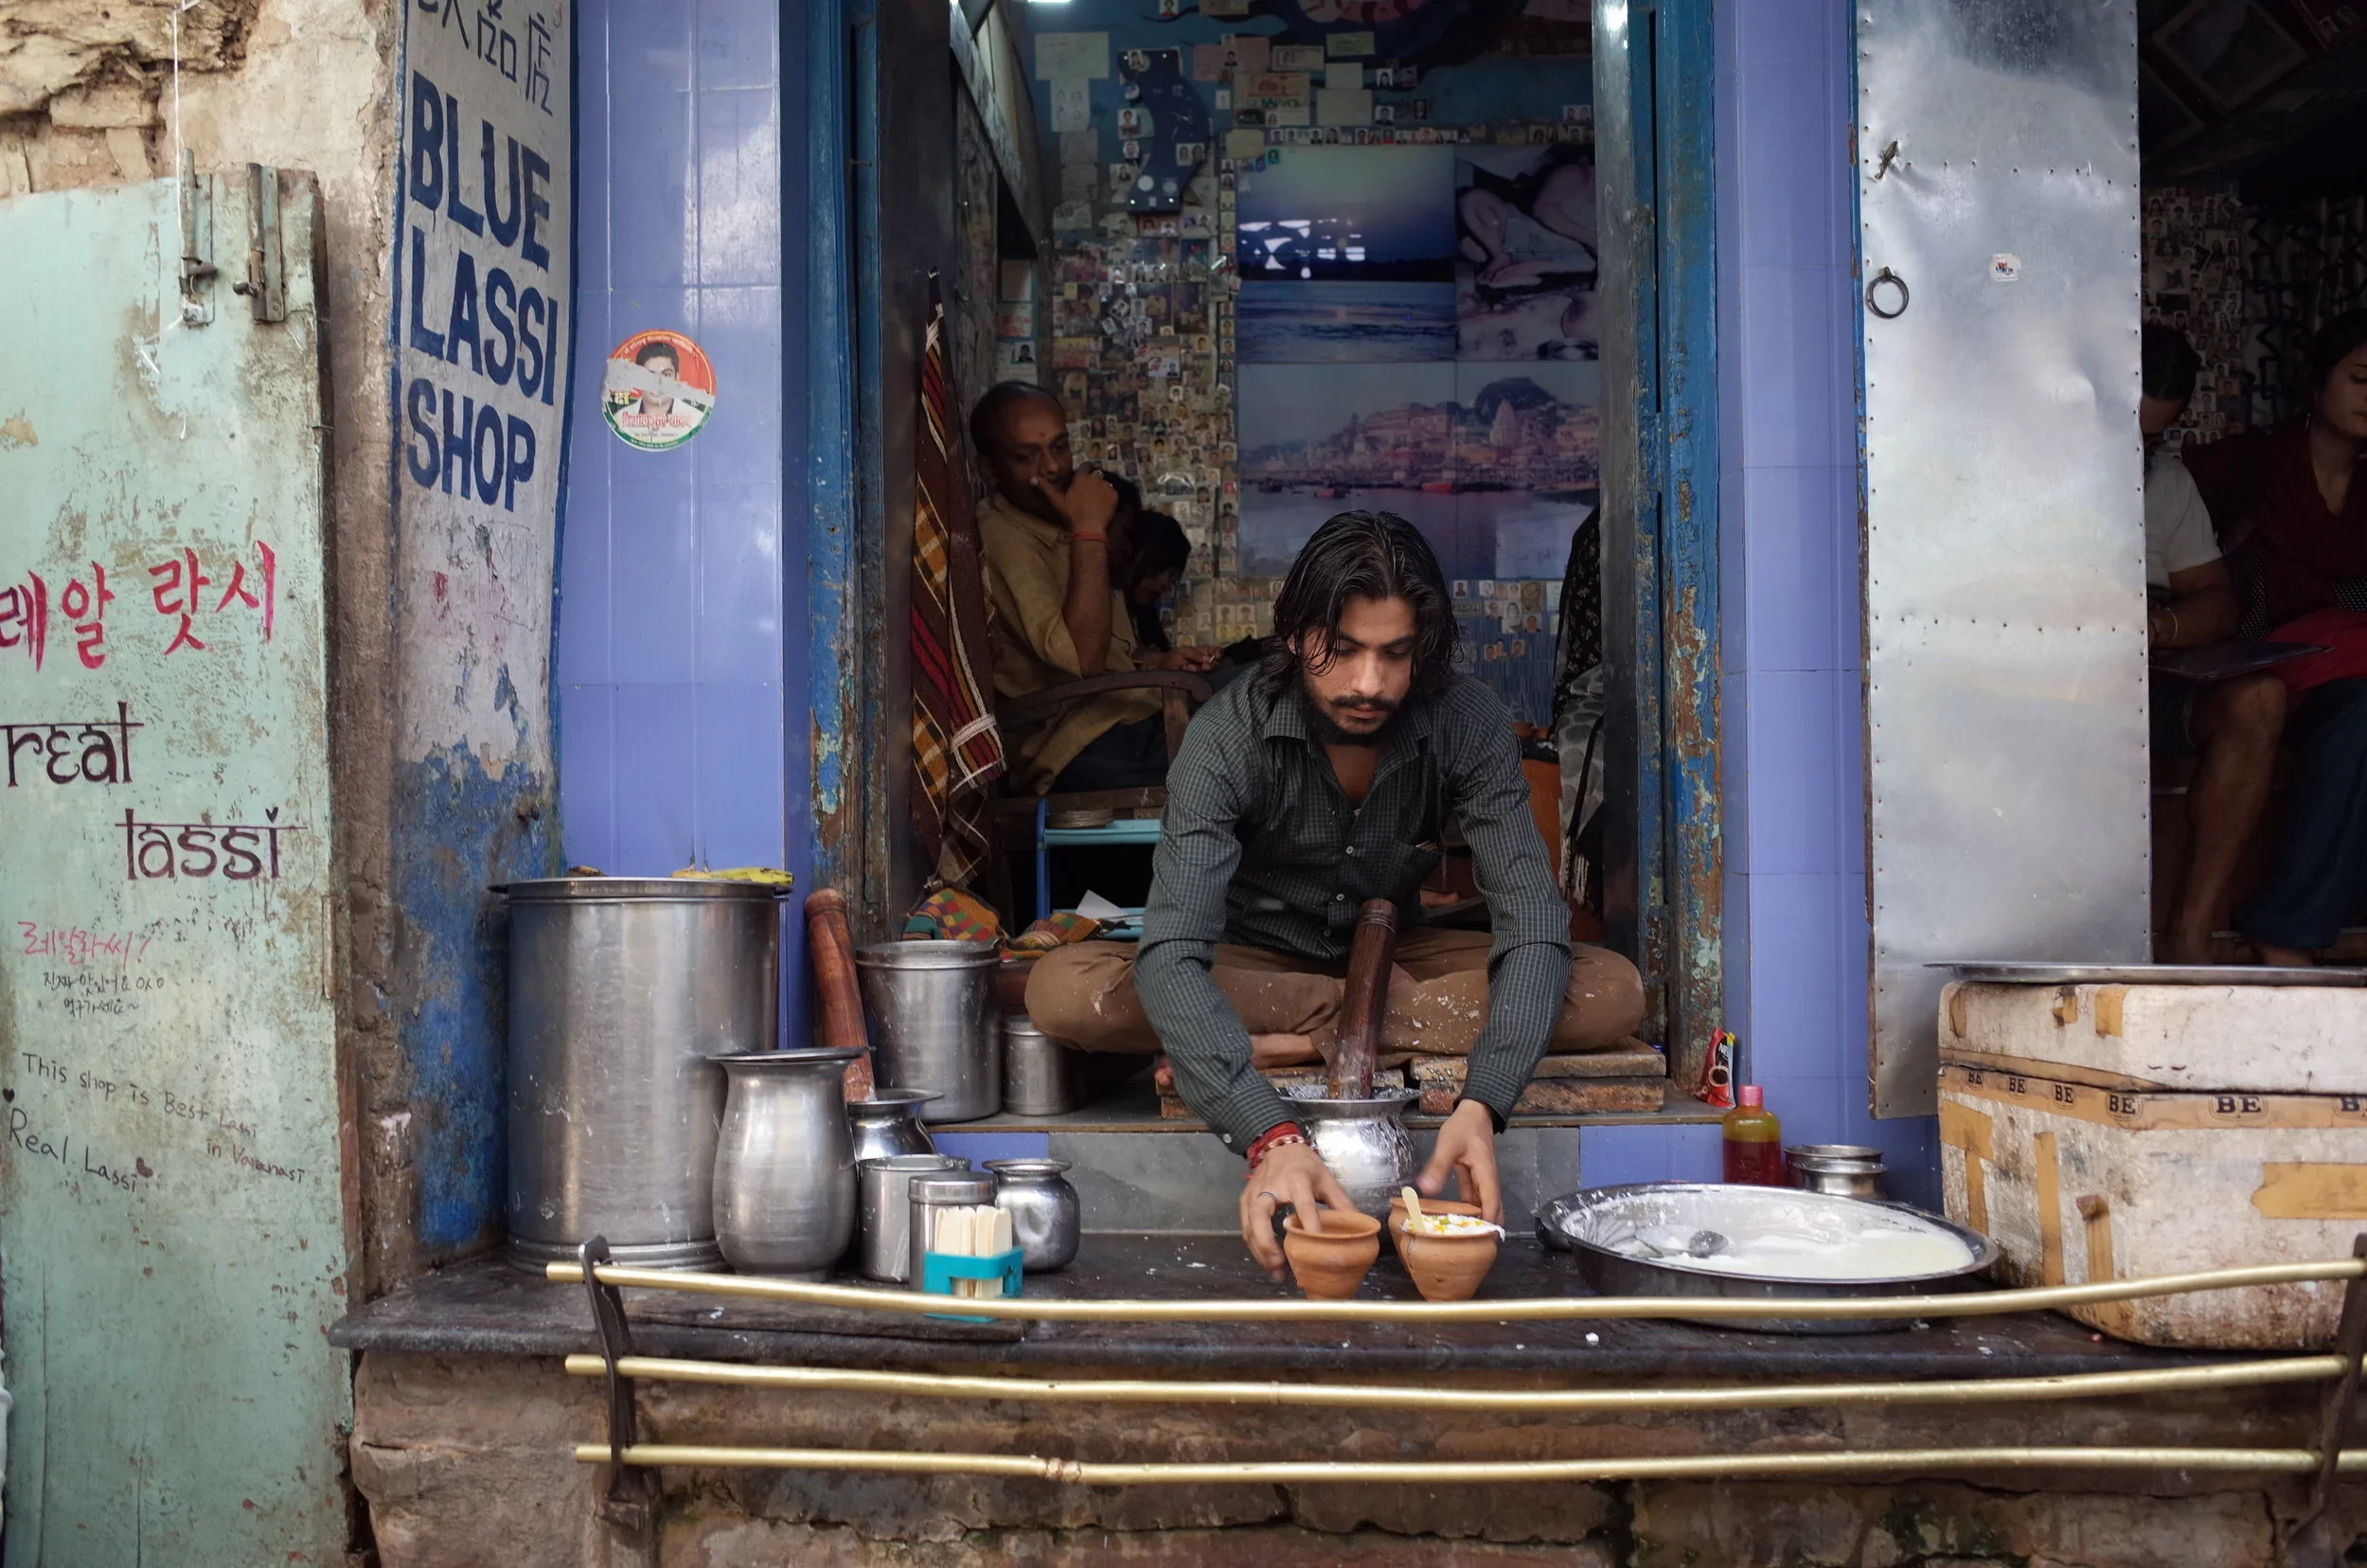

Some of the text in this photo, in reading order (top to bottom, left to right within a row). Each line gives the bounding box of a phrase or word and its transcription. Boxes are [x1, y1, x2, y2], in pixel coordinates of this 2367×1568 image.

[410, 69, 550, 273] BLUE
[410, 225, 558, 406] LASSI
[407, 378, 537, 512] SHOP
[148, 539, 276, 655] 랏시
[0, 701, 145, 788] real
[114, 806, 309, 881] lassi
[22, 1052, 67, 1083] This
[80, 1069, 116, 1102] shop
[129, 1083, 150, 1106] is
[163, 1090, 210, 1121] Best
[2008, 1077, 2026, 1094] BE
[2054, 1084, 2074, 1104] BE
[2109, 1094, 2137, 1114] BE
[2216, 1095, 2263, 1114] BE
[9, 1108, 138, 1193] Real Lassi
[205, 1137, 222, 1158] in
